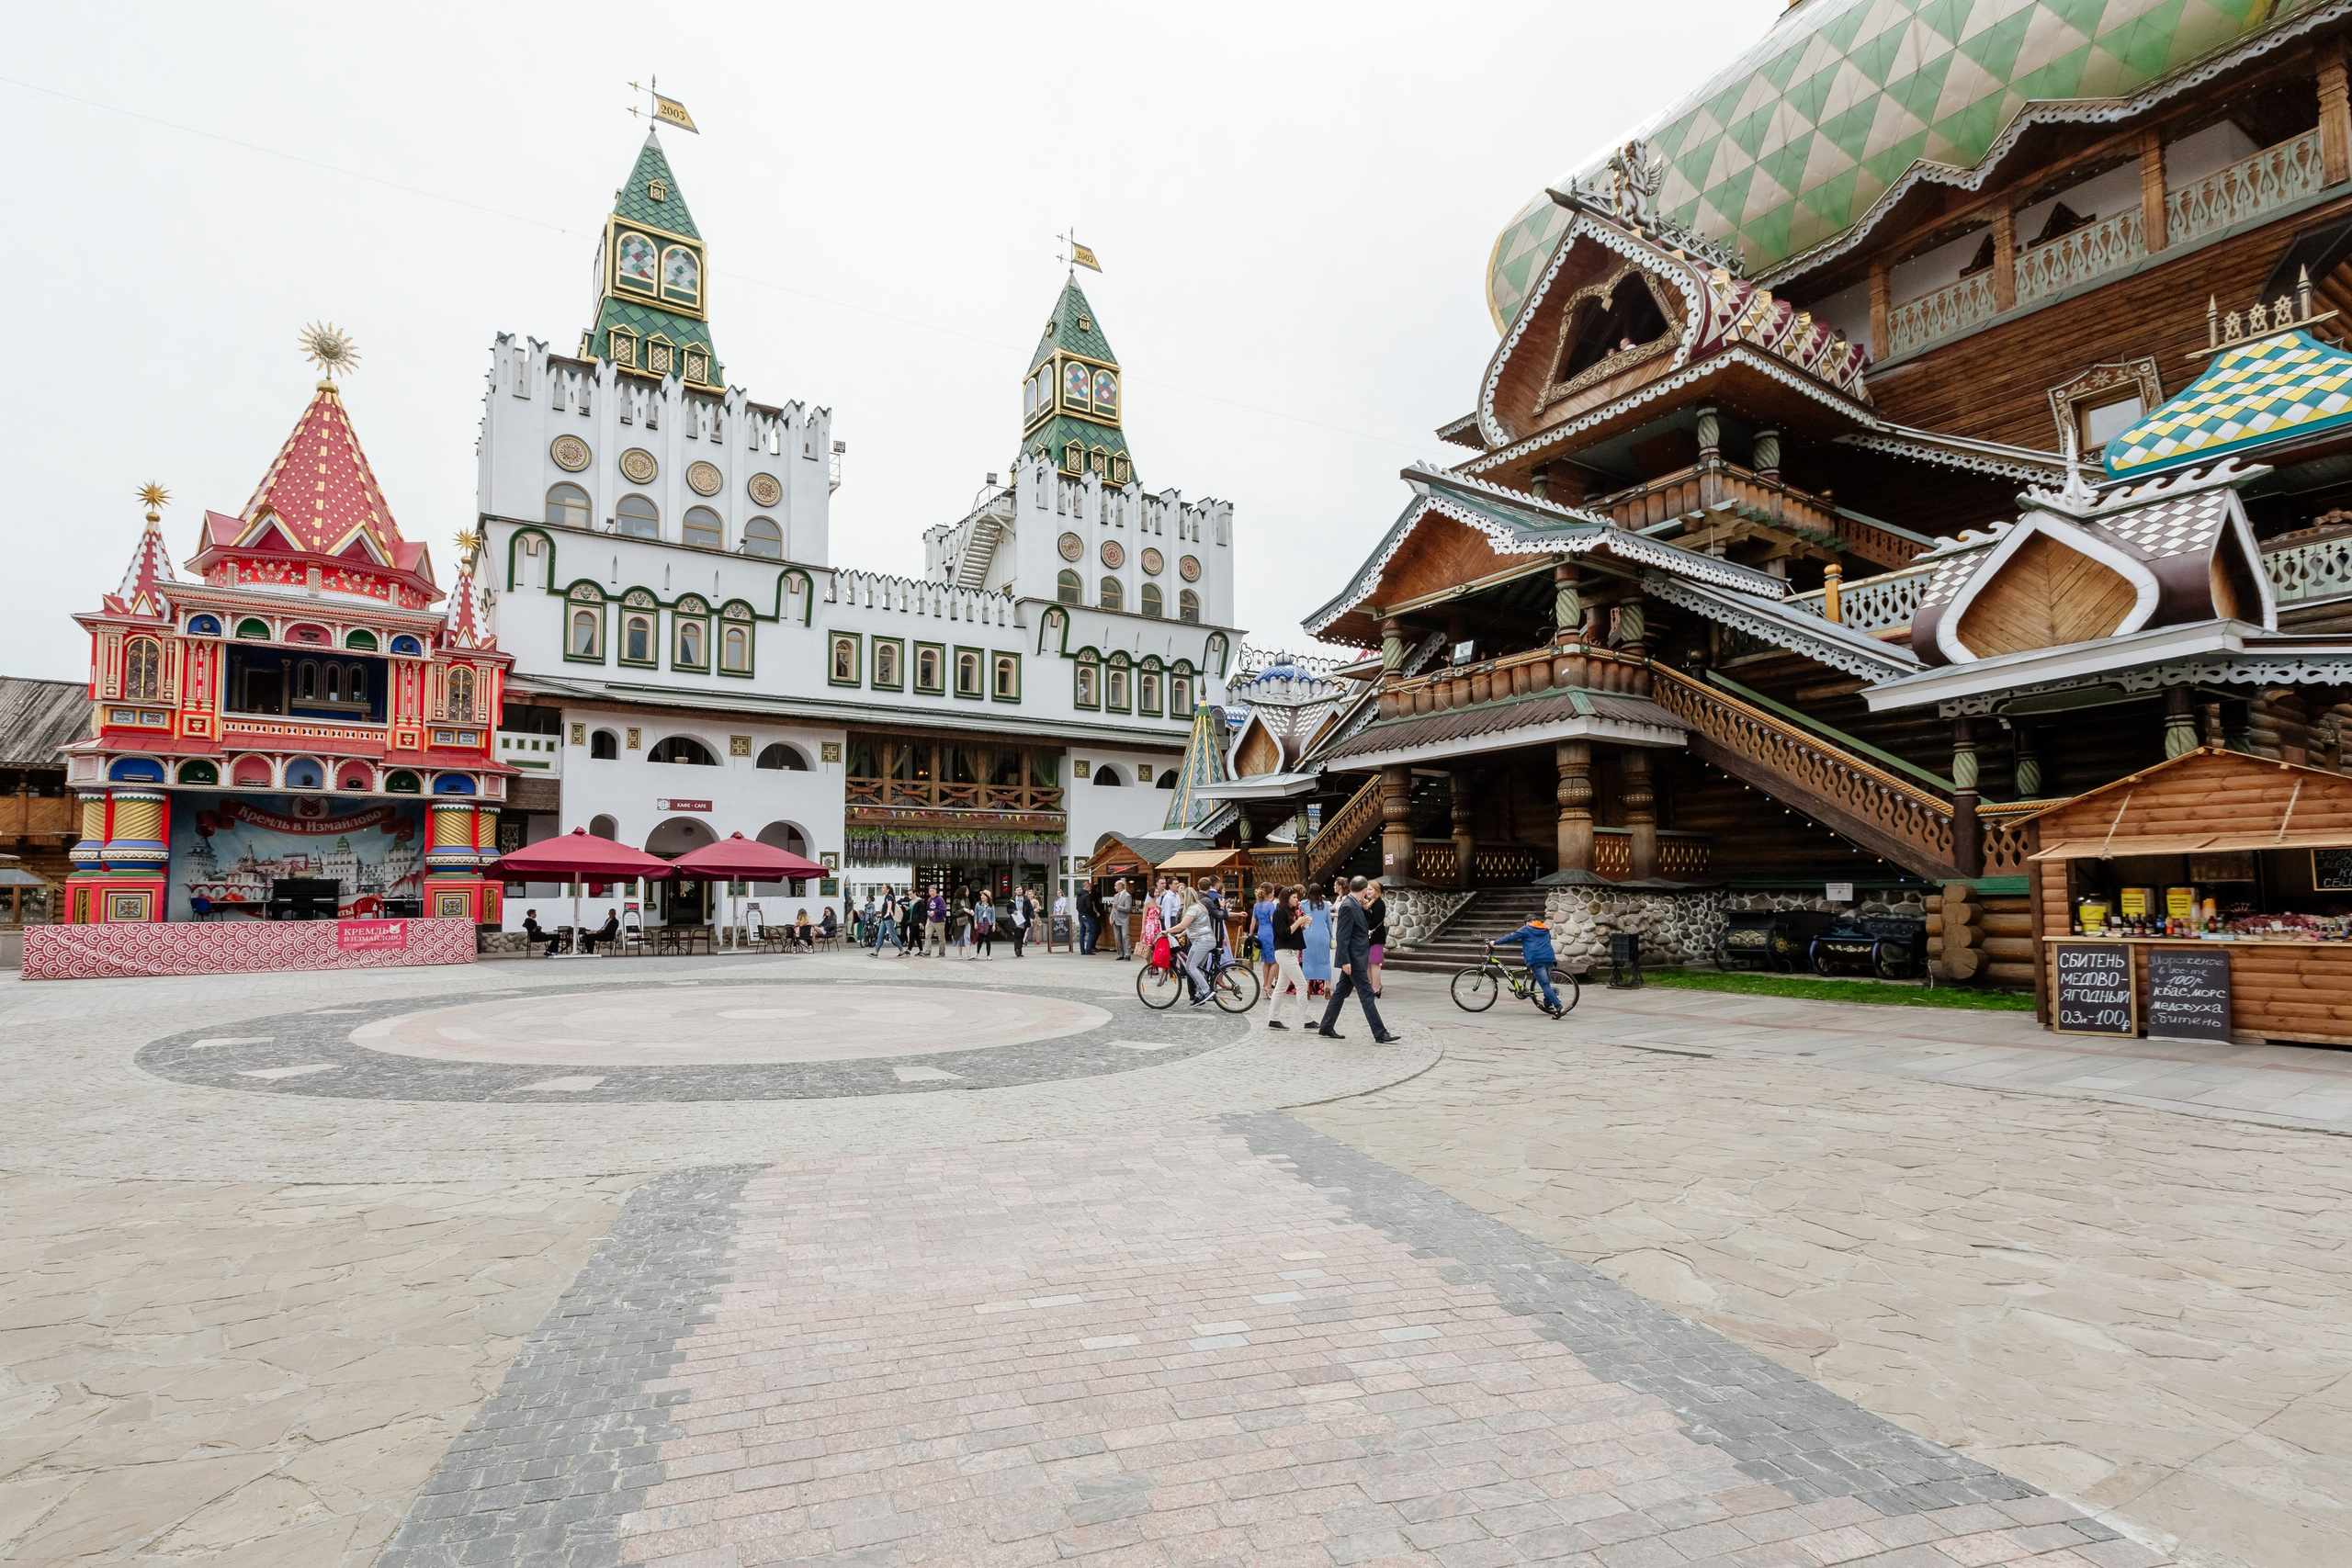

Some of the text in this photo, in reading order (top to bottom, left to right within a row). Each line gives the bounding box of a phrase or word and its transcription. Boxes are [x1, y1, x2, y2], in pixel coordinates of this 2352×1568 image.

[661, 104, 685, 120] 2003
[1077, 251, 1093, 263] 2003
[237, 805, 382, 832] Кремль в Измайлово
[344, 928, 390, 936] КРЕМЛЬ
[350, 934, 402, 942] ИЗМАЙЛОВО
[2059, 953, 2125, 968] СБИТЕНЬ
[2060, 971, 2129, 987] МЕДОВО-
[2060, 988, 2131, 1004] ЯГОДНЫЙ
[2150, 1012, 2222, 1027] сбитень
